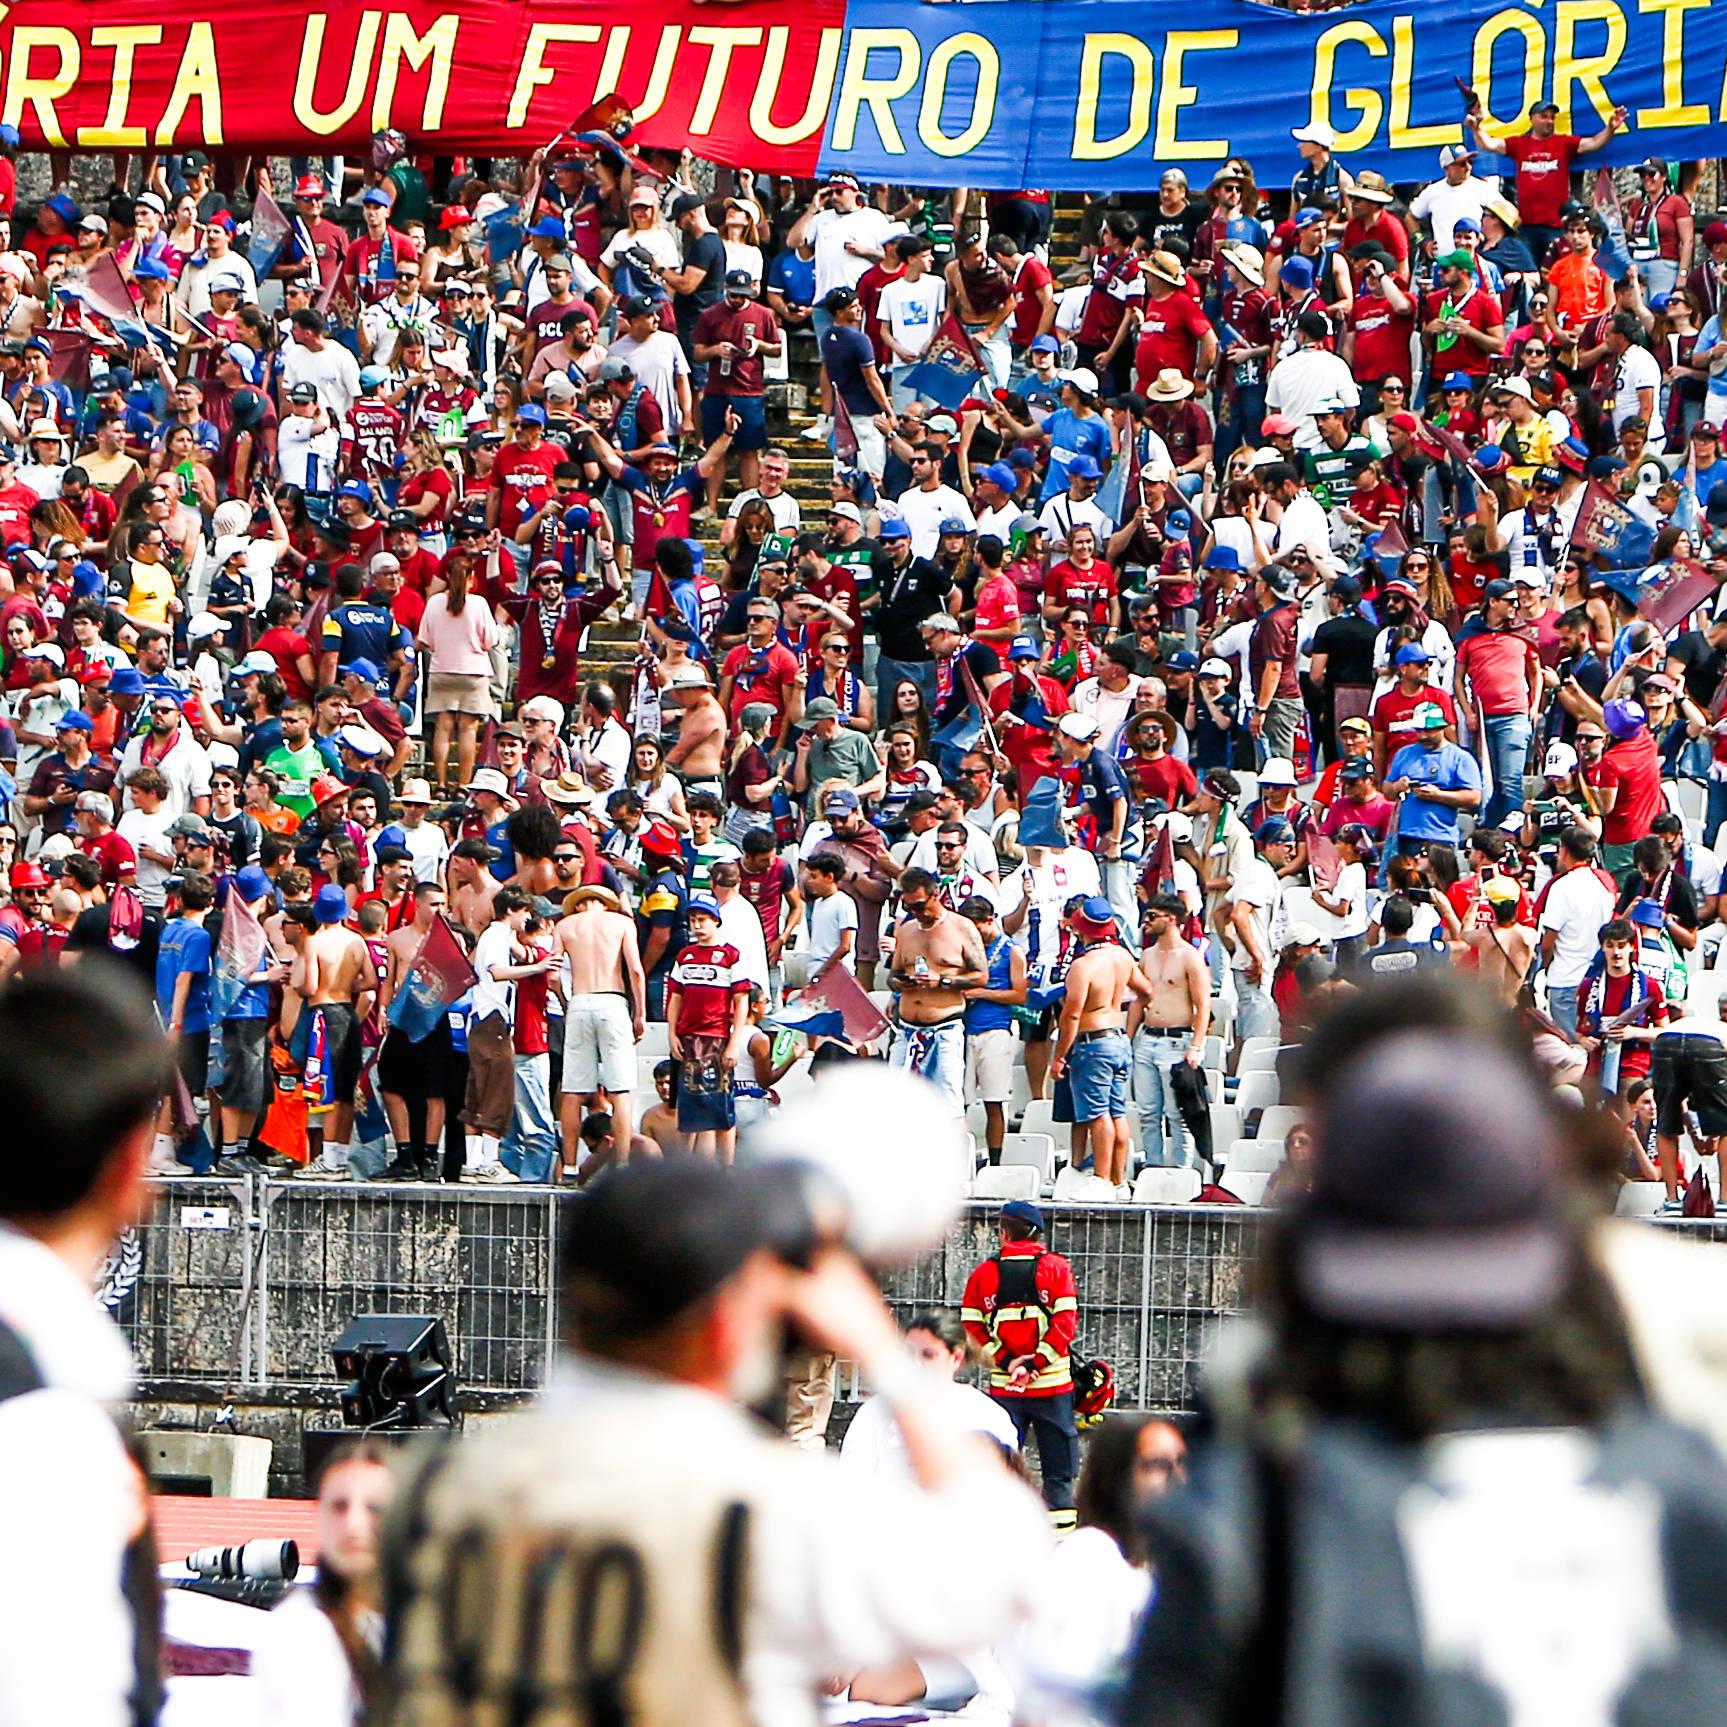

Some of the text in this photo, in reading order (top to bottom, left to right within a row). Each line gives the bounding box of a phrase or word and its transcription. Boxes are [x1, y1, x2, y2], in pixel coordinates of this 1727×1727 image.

[293, 9, 458, 135] UM
[506, 21, 1001, 160] FUTURO
[1071, 29, 1239, 160] DE
